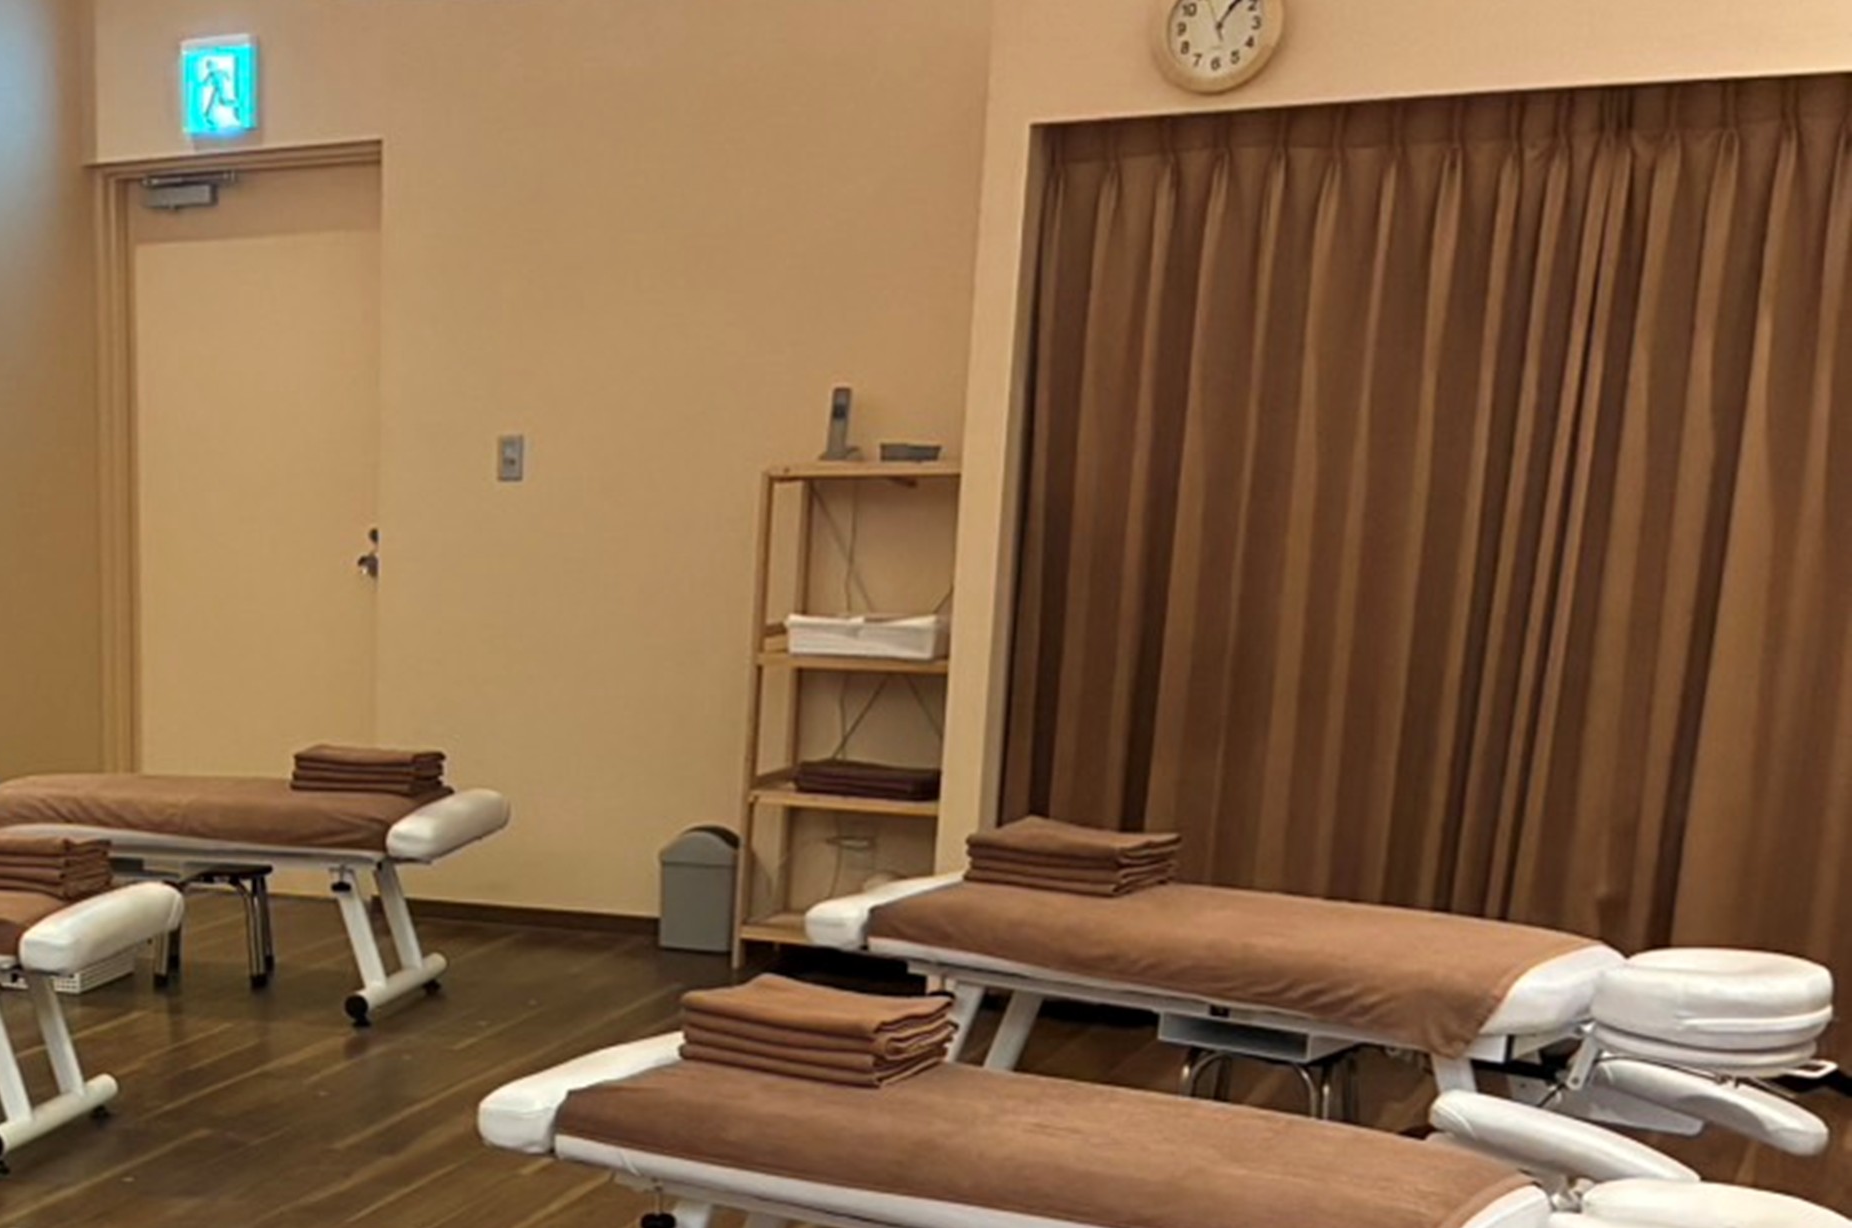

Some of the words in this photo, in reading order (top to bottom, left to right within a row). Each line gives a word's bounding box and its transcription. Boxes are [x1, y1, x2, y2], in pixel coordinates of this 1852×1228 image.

[1182, 3, 1197, 17] 10
[1177, 22, 1187, 36] 9
[1251, 16, 1261, 30] 3
[1180, 41, 1190, 55] 8
[1245, 36, 1254, 48] 4
[1192, 53, 1202, 67] 7
[1210, 57, 1221, 71] 6
[1230, 50, 1240, 64] 5
